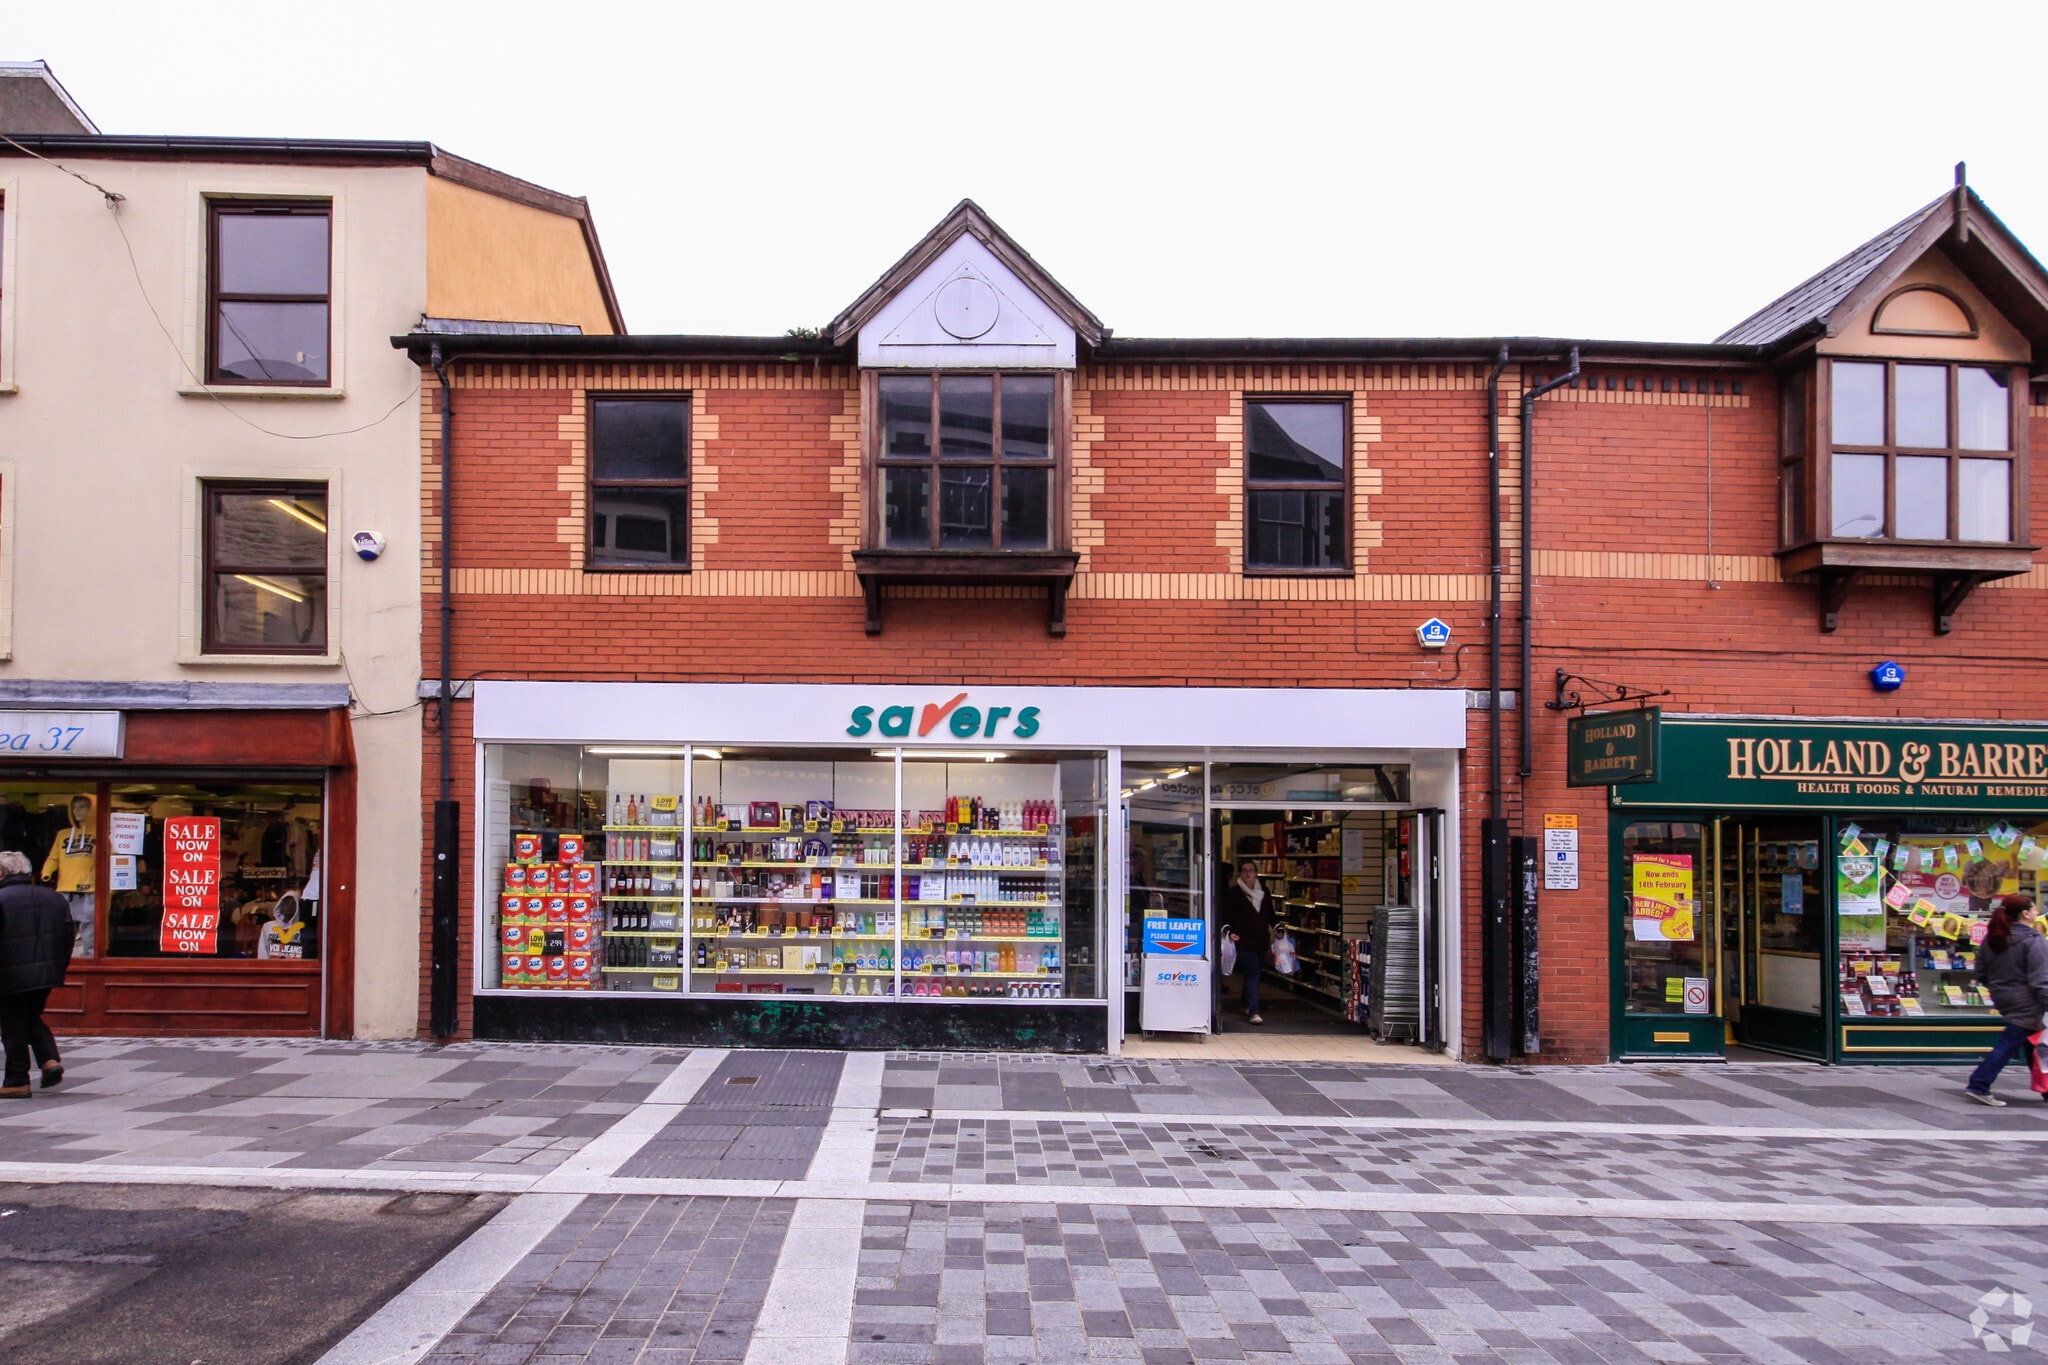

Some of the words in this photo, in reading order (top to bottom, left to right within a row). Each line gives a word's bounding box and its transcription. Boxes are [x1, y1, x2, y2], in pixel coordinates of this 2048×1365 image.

[846, 692, 1041, 738] savers
[39, 726, 85, 751] 37
[1585, 724, 1636, 743] HOLLAND
[1605, 742, 1614, 756] &
[1584, 755, 1637, 774] BARRETT
[1726, 737, 1892, 779] HOLLAND
[1899, 741, 1932, 784] &
[1797, 782, 1851, 794] HEALTH
[1855, 783, 1900, 795] FOODS
[1905, 785, 1915, 795] &
[169, 824, 216, 840] SALE
[176, 840, 209, 851] NOW
[183, 852, 203, 862] ON
[169, 869, 215, 885] SALE
[1646, 870, 1660, 878] Now
[175, 885, 208, 895] NOW
[1656, 881, 1687, 889] February
[182, 897, 202, 907] ON
[1635, 900, 1651, 908] NEW
[1651, 901, 1670, 913] LINES
[1635, 907, 1663, 919] ADDED!
[166, 913, 214, 929] SALE
[1147, 921, 1167, 930] FREE
[1169, 921, 1202, 931] LEAFLET
[173, 929, 206, 940] NOW
[179, 941, 199, 951] ON
[281, 945, 302, 954] JEANS
[1158, 971, 1197, 982] savers
